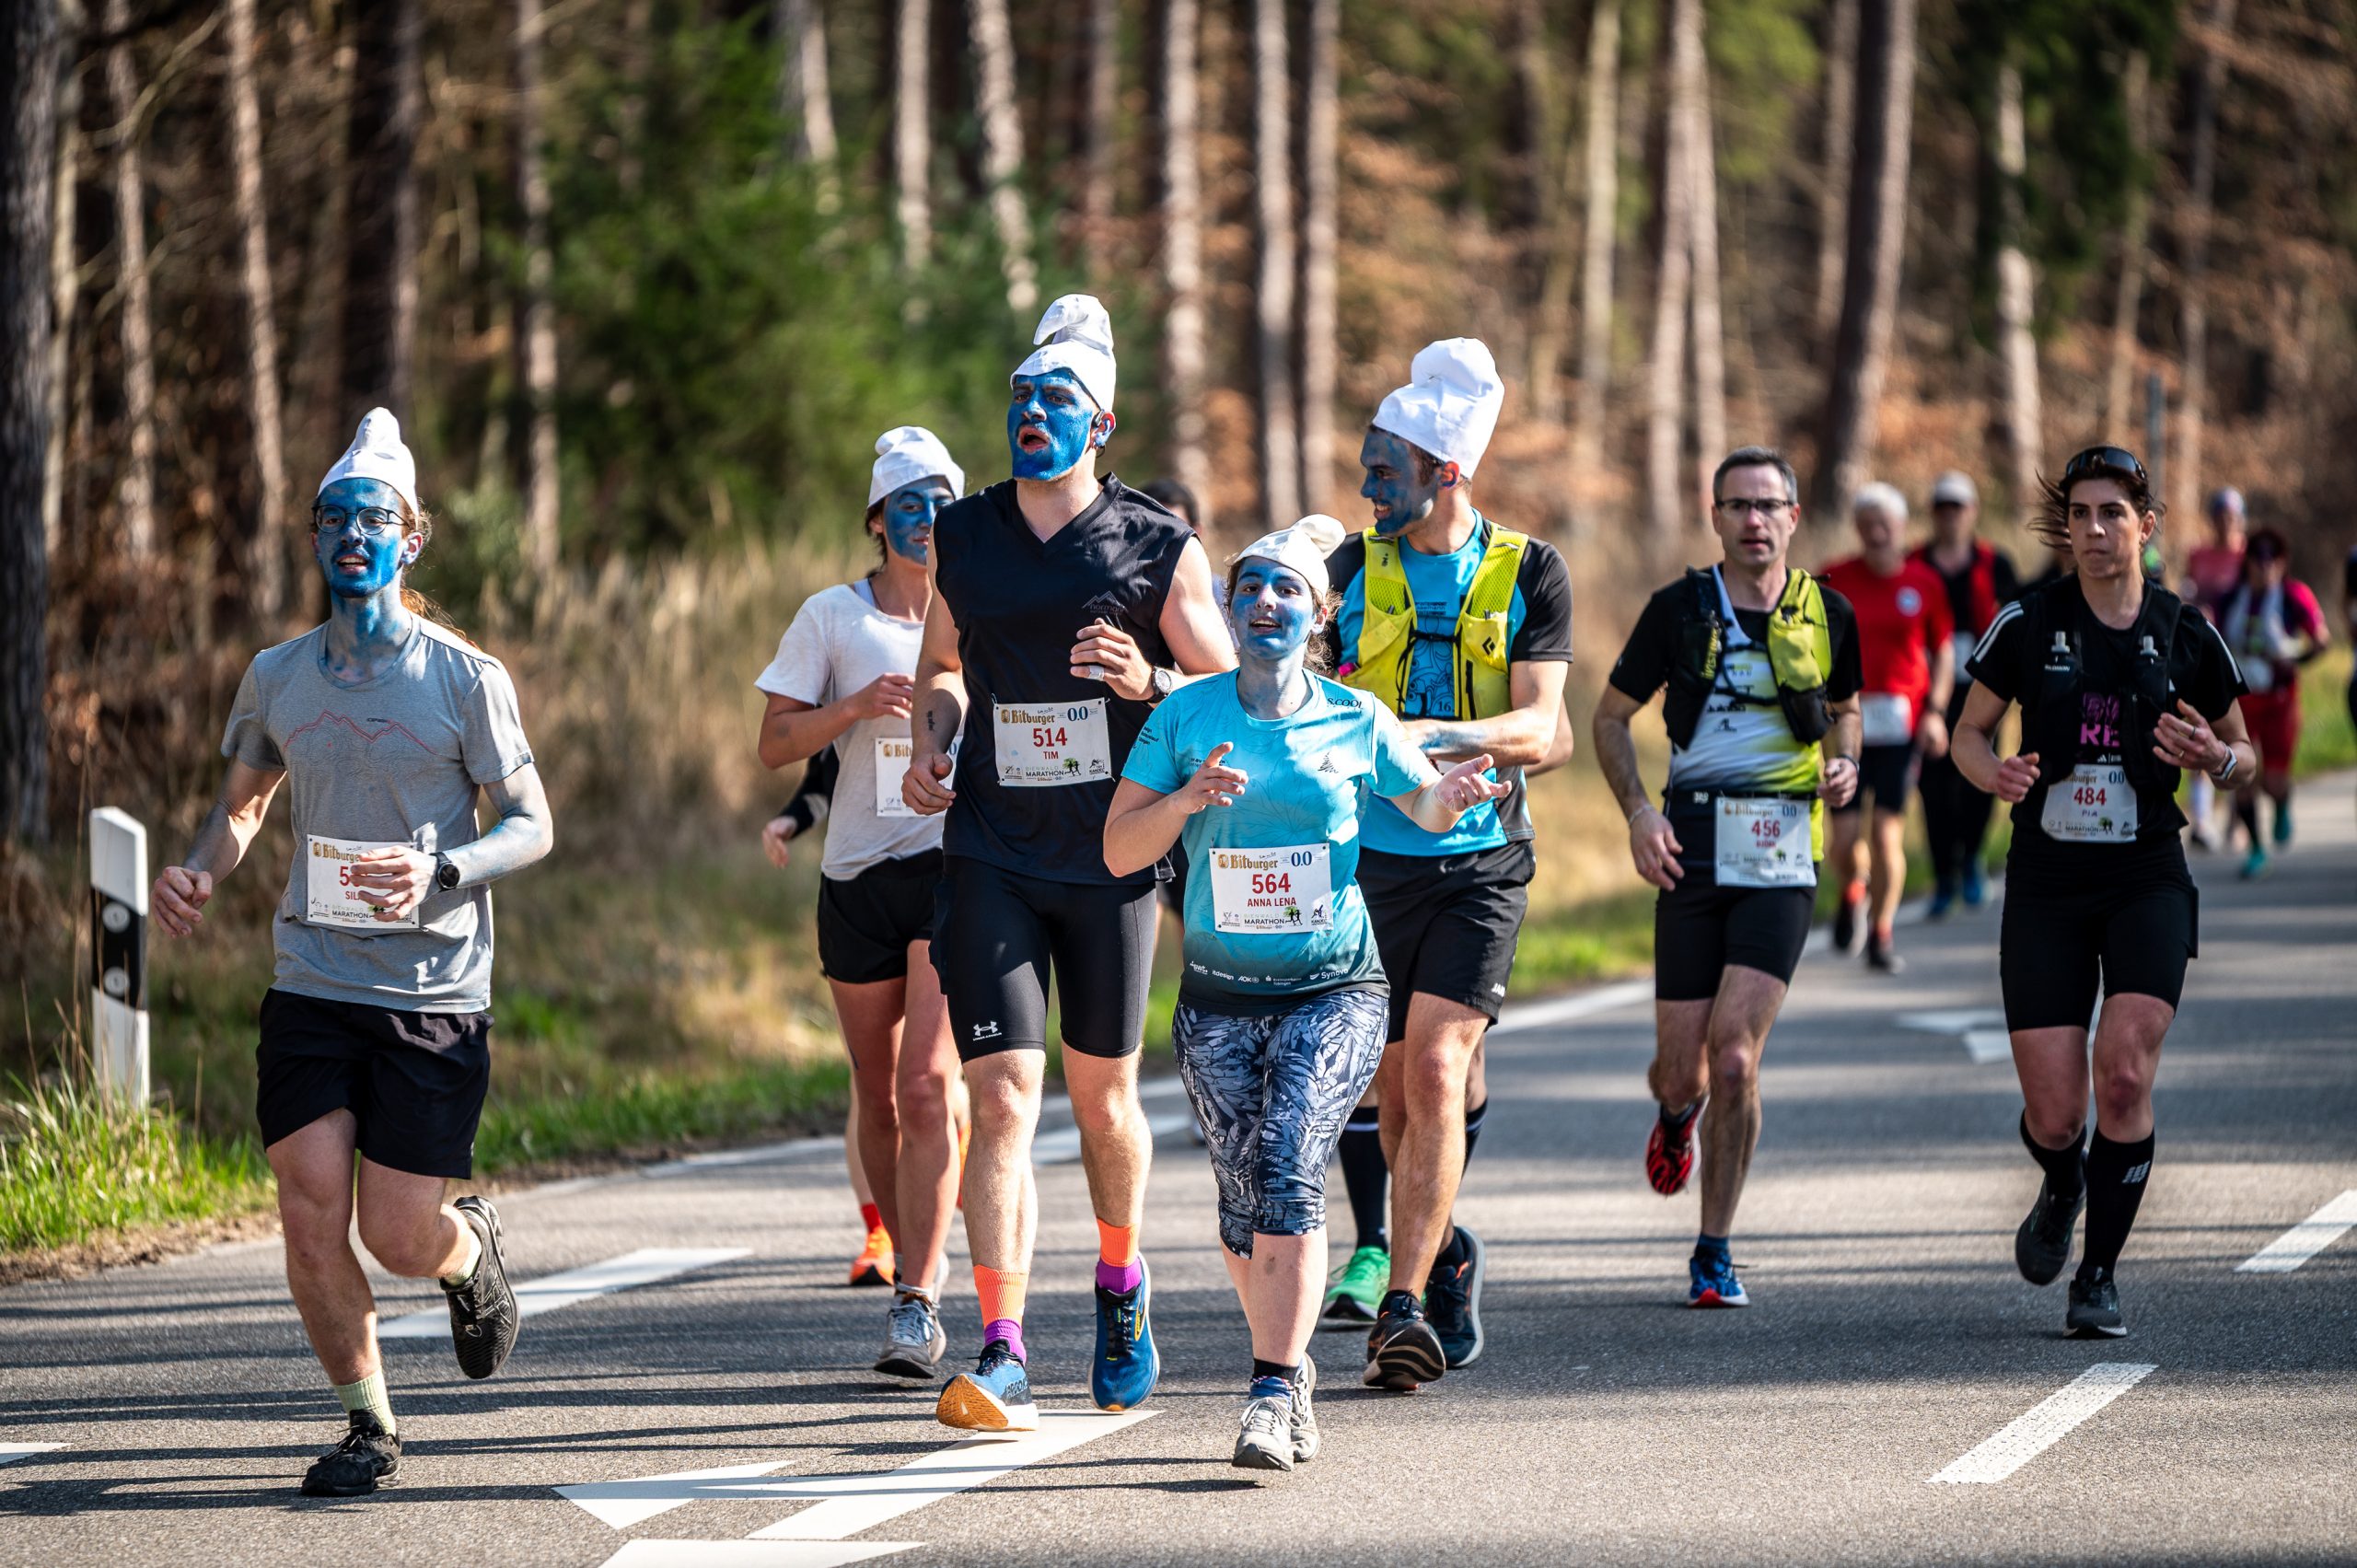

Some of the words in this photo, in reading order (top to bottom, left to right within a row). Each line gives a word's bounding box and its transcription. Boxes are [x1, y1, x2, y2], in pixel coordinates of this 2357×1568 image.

[1011, 709, 1055, 725] Bitburger
[1067, 705, 1088, 722] 0.0
[1033, 727, 1067, 748] 514
[1043, 751, 1059, 760] TIM
[2073, 786, 2107, 807] 484
[2082, 809, 2098, 818] PIA
[1751, 819, 1781, 838] 456
[322, 842, 360, 864] Bitburge
[1230, 854, 1278, 871] Bitburger
[1291, 851, 1312, 866] 0.0
[1252, 873, 1291, 894] 564
[1248, 899, 1271, 907] ANNA
[1274, 897, 1296, 906] LENA
[331, 910, 369, 919] MARATHON
[1212, 970, 1235, 981] itdesign
[1237, 975, 1252, 983] AOK
[1321, 969, 1349, 980] Synovo
